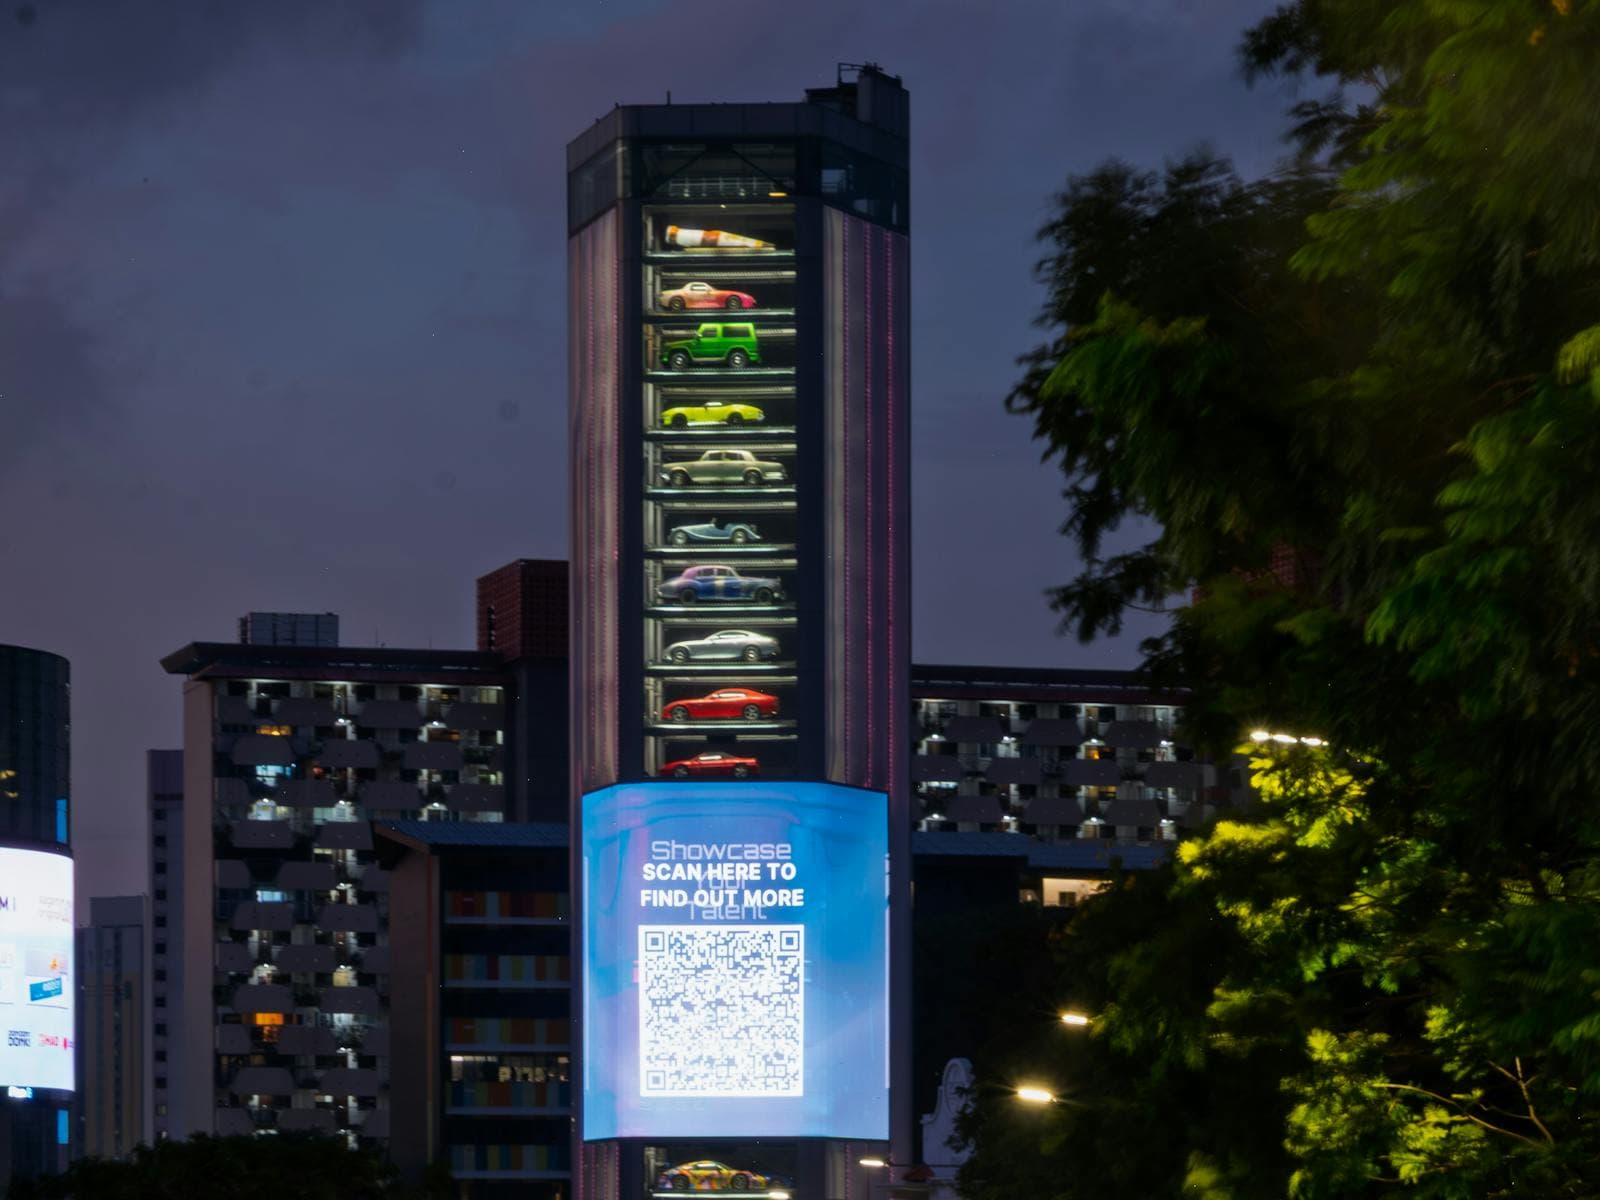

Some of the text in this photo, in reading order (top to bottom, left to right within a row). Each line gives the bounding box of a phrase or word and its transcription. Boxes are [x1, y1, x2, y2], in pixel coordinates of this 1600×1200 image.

[651, 840, 792, 860] Showcase
[642, 863, 797, 881] SCAN HERE TO
[640, 888, 804, 907] FIND OUT MORE
